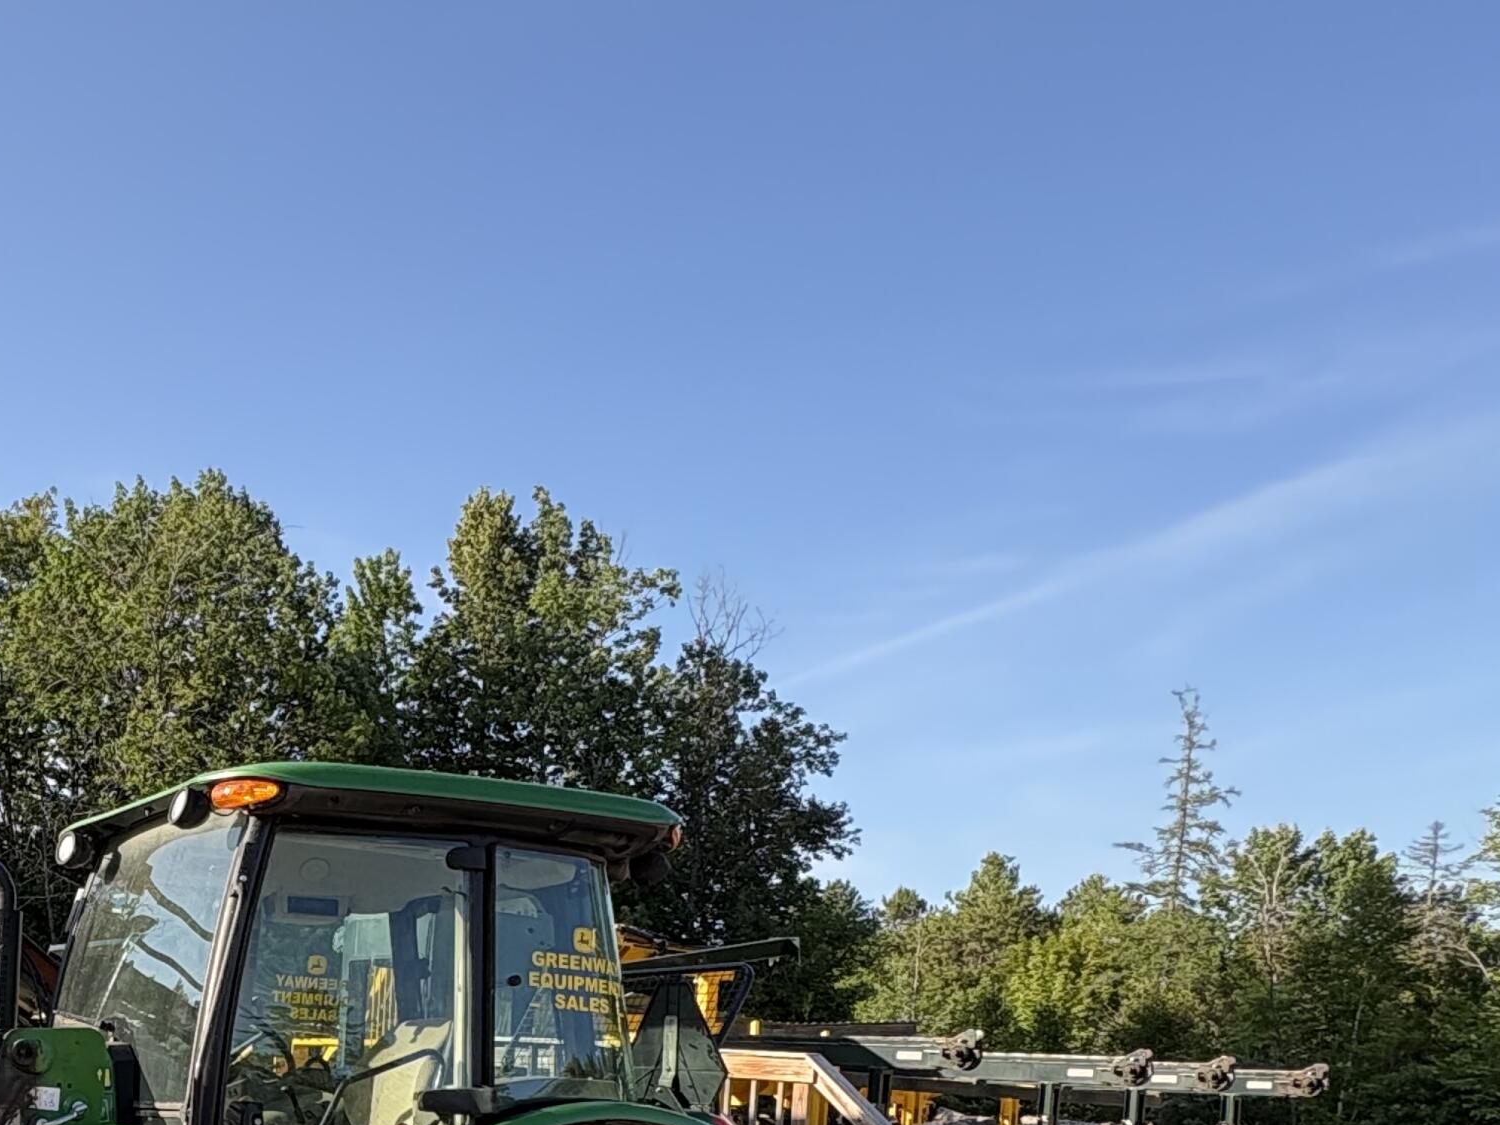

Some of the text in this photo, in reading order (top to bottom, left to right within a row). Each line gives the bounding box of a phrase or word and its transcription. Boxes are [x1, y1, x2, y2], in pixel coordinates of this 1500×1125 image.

[531, 951, 618, 976] GREENWA
[528, 971, 622, 998] EQUIPMEN
[554, 993, 610, 1014] SALES
